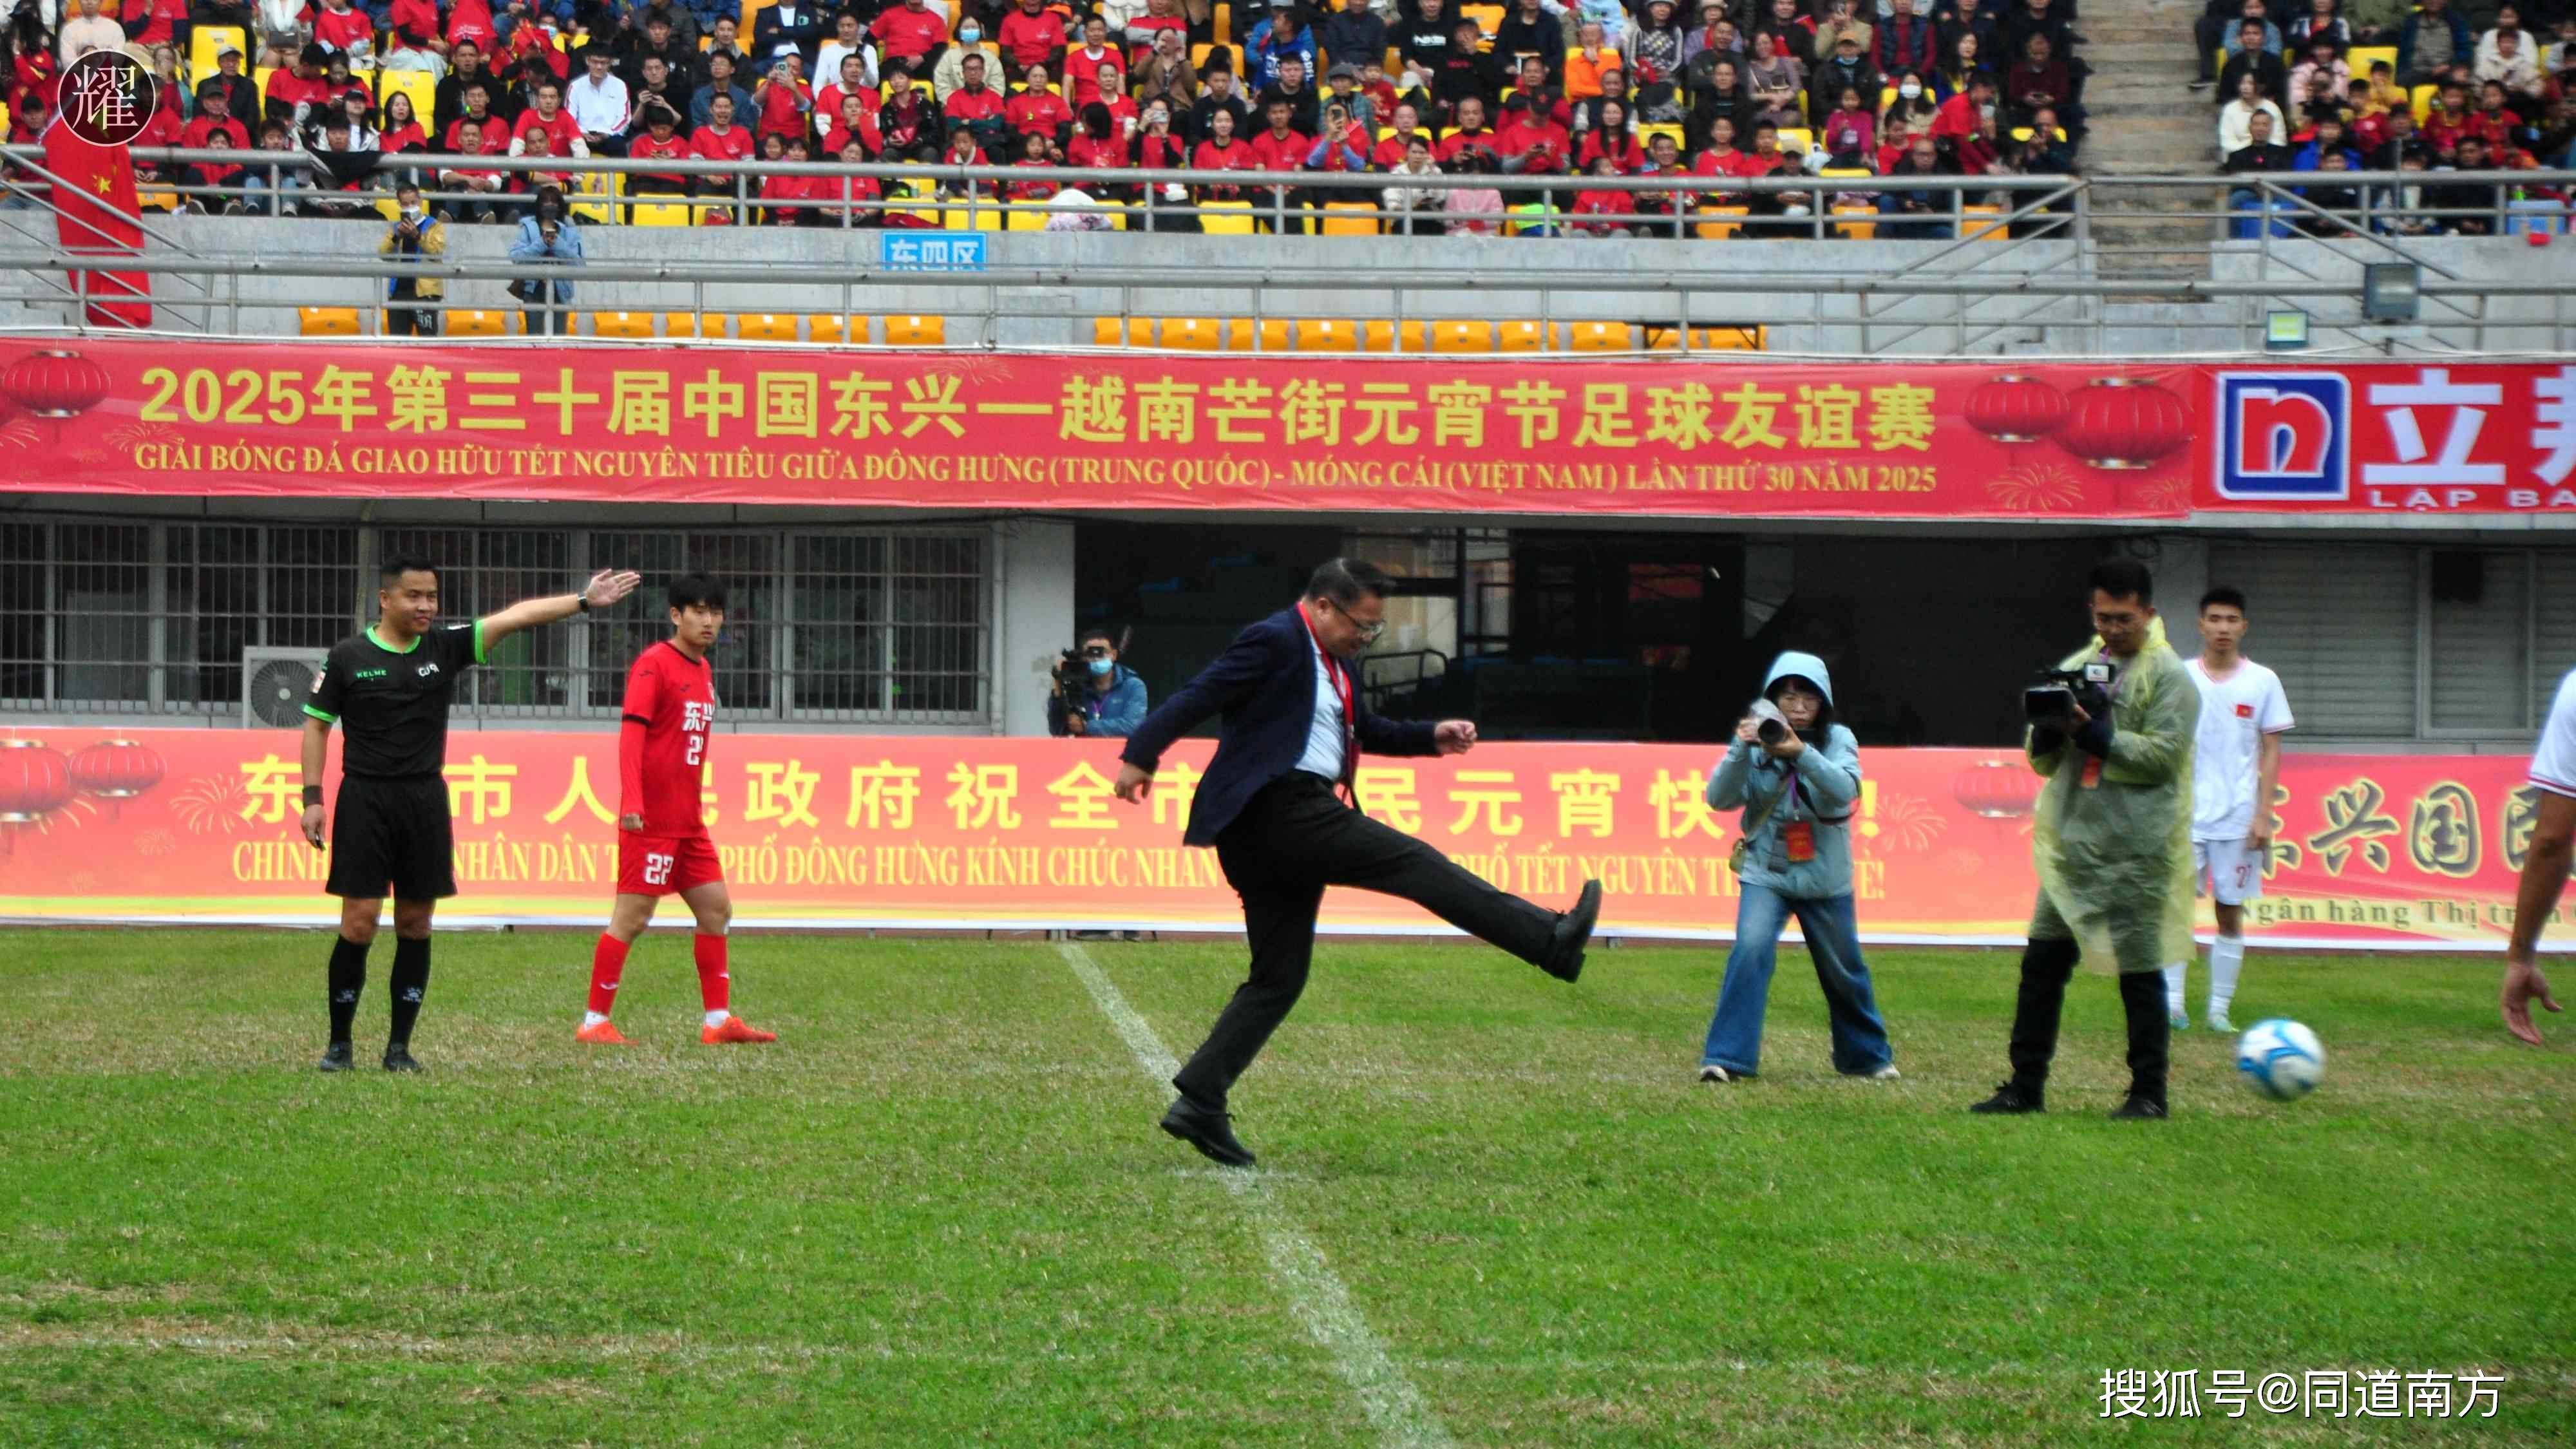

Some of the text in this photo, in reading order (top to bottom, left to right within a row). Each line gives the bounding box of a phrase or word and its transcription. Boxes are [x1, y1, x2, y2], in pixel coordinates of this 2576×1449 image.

[890, 238, 980, 271] 东四区
[135, 438, 202, 471] GIẢI
[211, 440, 296, 473] BÓNG
[303, 440, 344, 474] ĐÁ
[352, 448, 430, 475] GIAO
[509, 442, 565, 477] TẾT
[574, 446, 699, 478] NGUYÊN
[705, 446, 774, 479] TIÊU
[865, 450, 951, 482] ĐÔNG
[1292, 455, 1382, 487] MÓNG
[1765, 466, 1795, 491] 30
[1803, 461, 1870, 491] NĂM
[1879, 466, 1937, 492] 2025
[355, 669, 387, 679] KELME
[232, 829, 332, 885] CHÍNH
[538, 831, 602, 885] DÂN
[784, 835, 869, 887] ĐÔNG
[967, 837, 1041, 888] KÍNH
[1046, 837, 1130, 889] CHÚC
[1514, 841, 1573, 895] TẾT
